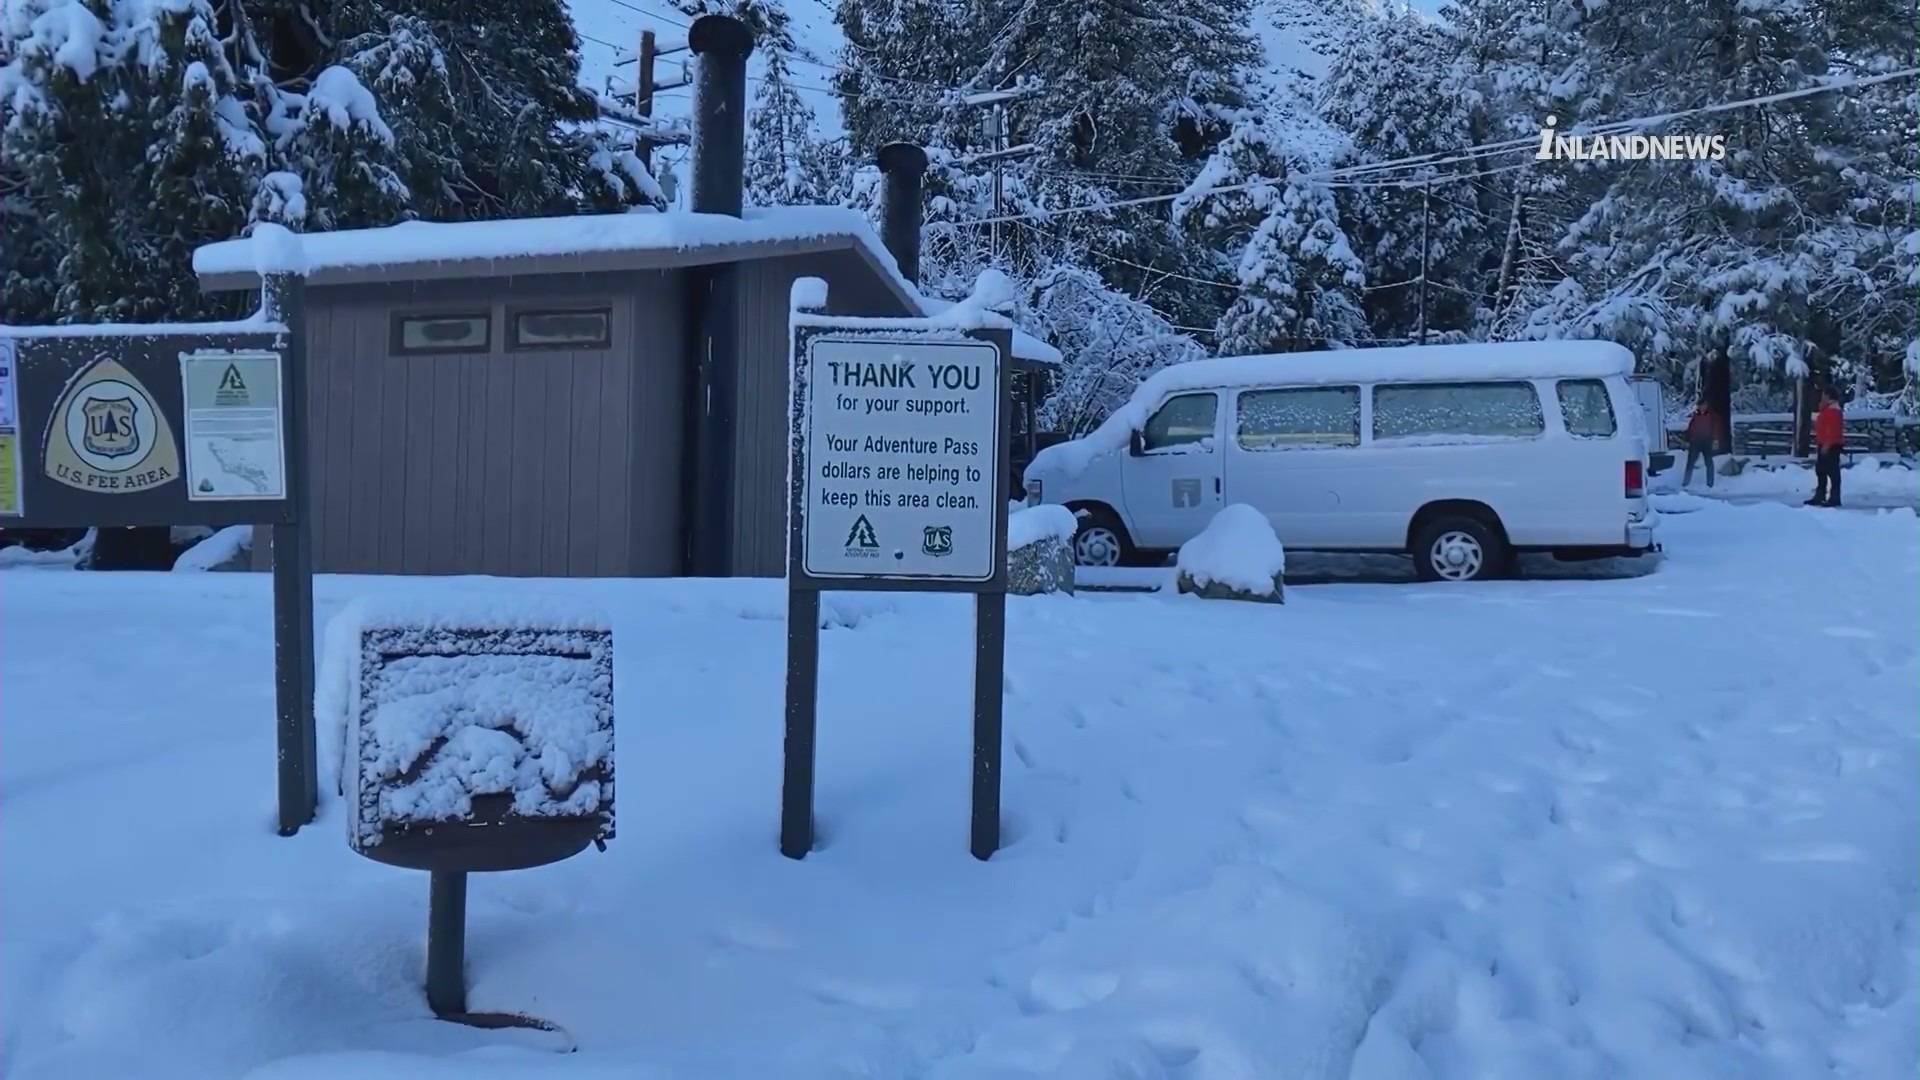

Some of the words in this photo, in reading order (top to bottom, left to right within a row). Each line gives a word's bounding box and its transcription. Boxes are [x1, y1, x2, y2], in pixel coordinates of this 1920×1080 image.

[828, 361, 915, 388] THANK
[928, 364, 980, 390] YOU
[837, 393, 858, 410] for
[866, 398, 899, 415] your
[906, 398, 970, 416] support.
[826, 433, 858, 452] Your
[864, 435, 937, 454] Adventure
[944, 437, 978, 456] Pass
[56, 464, 83, 484] U.S.
[87, 474, 120, 488] FEE
[124, 466, 171, 488] AREA
[822, 461, 870, 480] dollars
[877, 466, 901, 480] are
[907, 463, 960, 485] helping
[966, 465, 981, 482] to
[822, 489, 858, 509] keep
[865, 489, 891, 507] this
[898, 494, 929, 508] area
[936, 492, 979, 509] clean.
